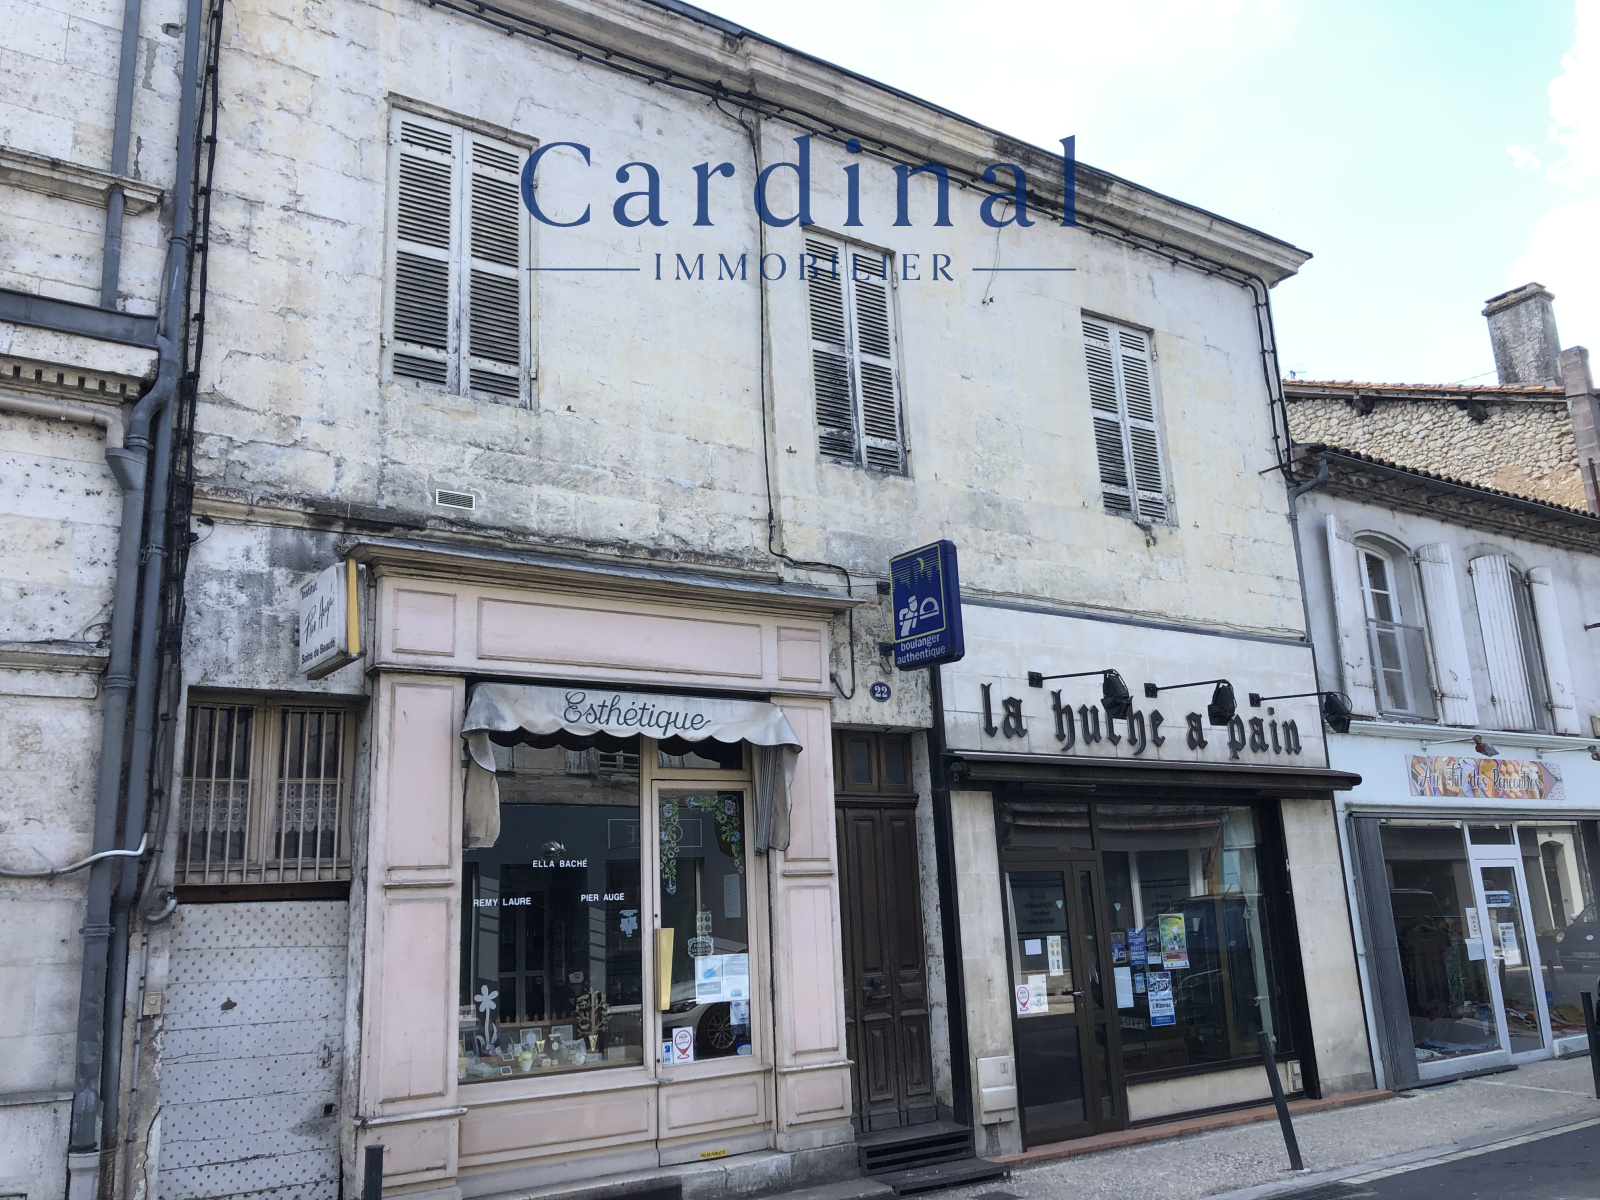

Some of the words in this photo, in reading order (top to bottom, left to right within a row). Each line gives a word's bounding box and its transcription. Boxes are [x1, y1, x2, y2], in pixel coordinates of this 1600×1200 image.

[301, 581, 318, 600] Institut
[900, 633, 940, 652] boulanger
[301, 652, 314, 665] Soins
[313, 648, 320, 658] de
[897, 645, 946, 665] authentique
[874, 685, 888, 698] 22
[563, 691, 712, 736] Esthétique
[980, 683, 1029, 738] la
[1226, 706, 1303, 760] pain
[1418, 763, 1441, 790] Au
[1469, 769, 1488, 790] des
[1492, 766, 1541, 792] Rencontres
[532, 859, 555, 868] ELLA
[559, 857, 588, 868] BACHÉ
[473, 898, 499, 907] REMY
[502, 896, 532, 906] LAURE
[580, 893, 600, 902] PIER
